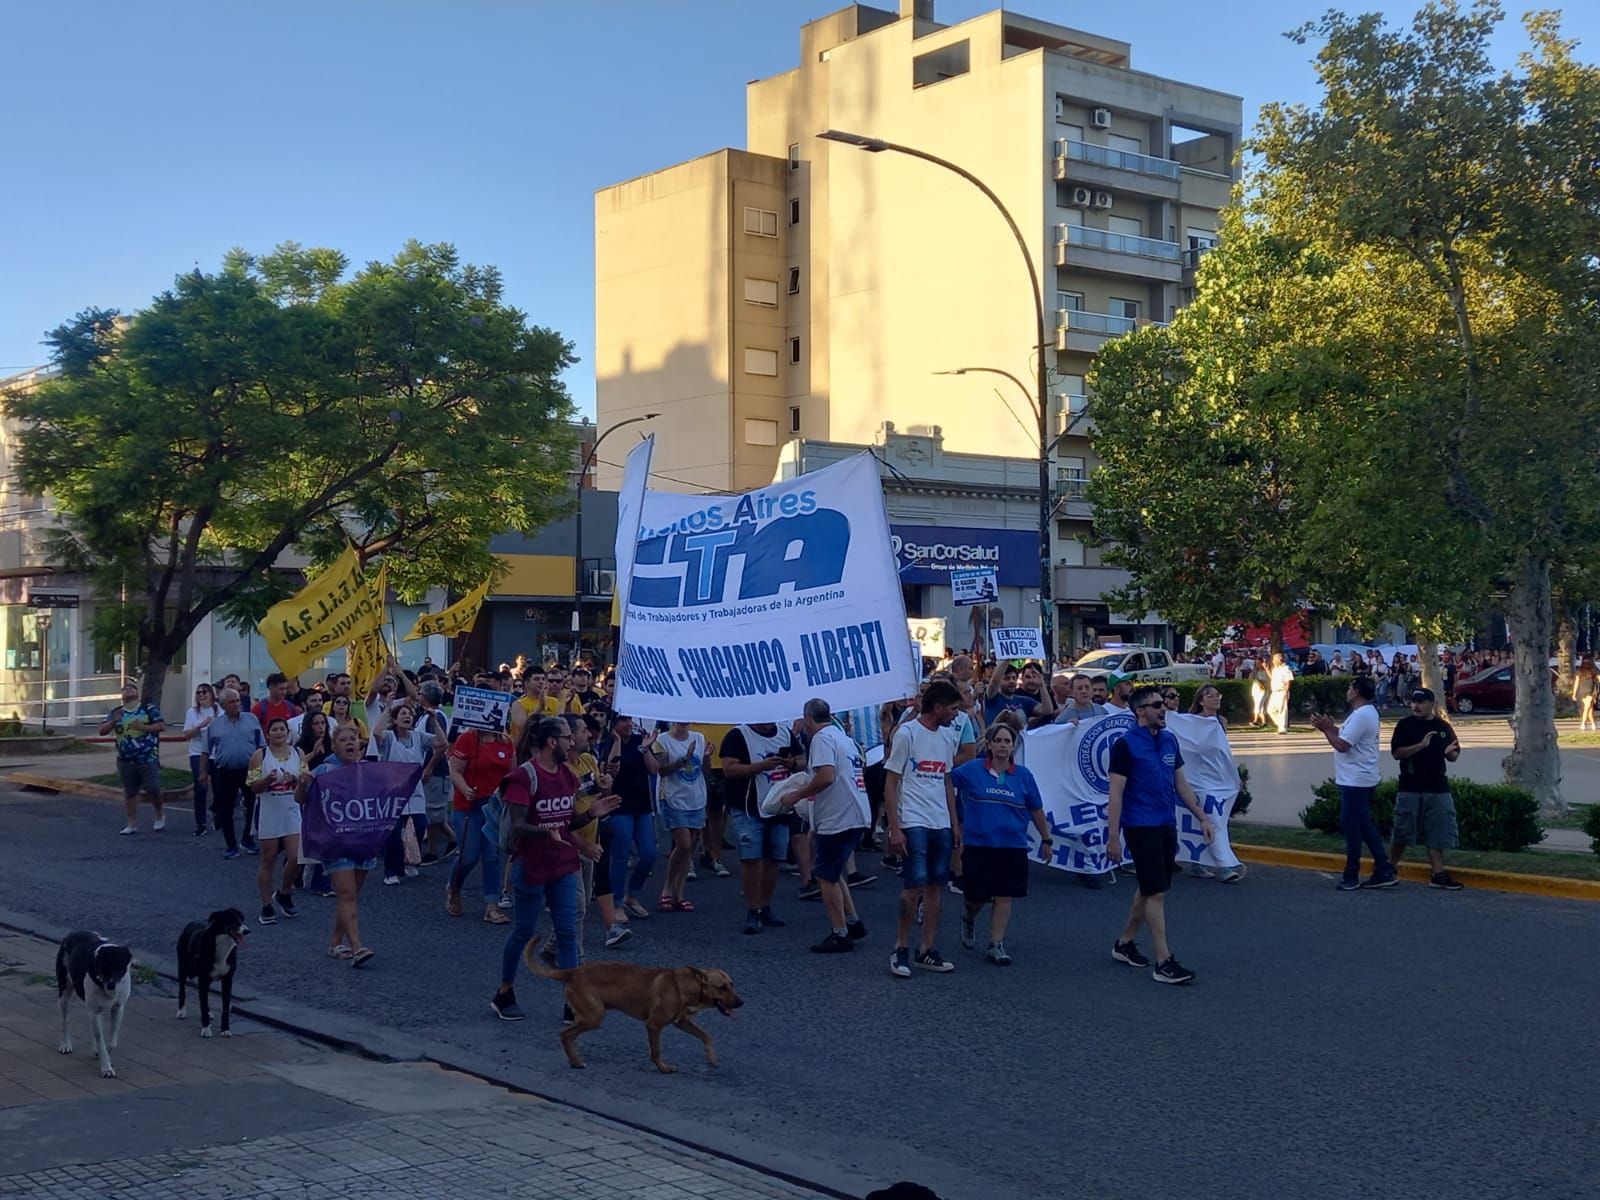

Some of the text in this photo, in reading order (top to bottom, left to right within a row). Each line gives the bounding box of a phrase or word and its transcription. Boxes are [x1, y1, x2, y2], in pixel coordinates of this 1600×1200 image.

[733, 490, 816, 524] Aires
[904, 543, 999, 561] SanCorSalud
[638, 611, 647, 621] de
[647, 612, 700, 624] Trabajadores
[702, 611, 707, 621] y
[709, 603, 767, 619] Trabajadoras
[770, 600, 781, 610] de
[784, 598, 792, 608] la
[795, 590, 845, 606] Argentina
[678, 638, 792, 698] CHACABUCO
[800, 620, 890, 687] ALBERTI
[999, 640, 1019, 657] NO
[1105, 718, 1132, 729] GENER
[330, 796, 407, 823] SOEME
